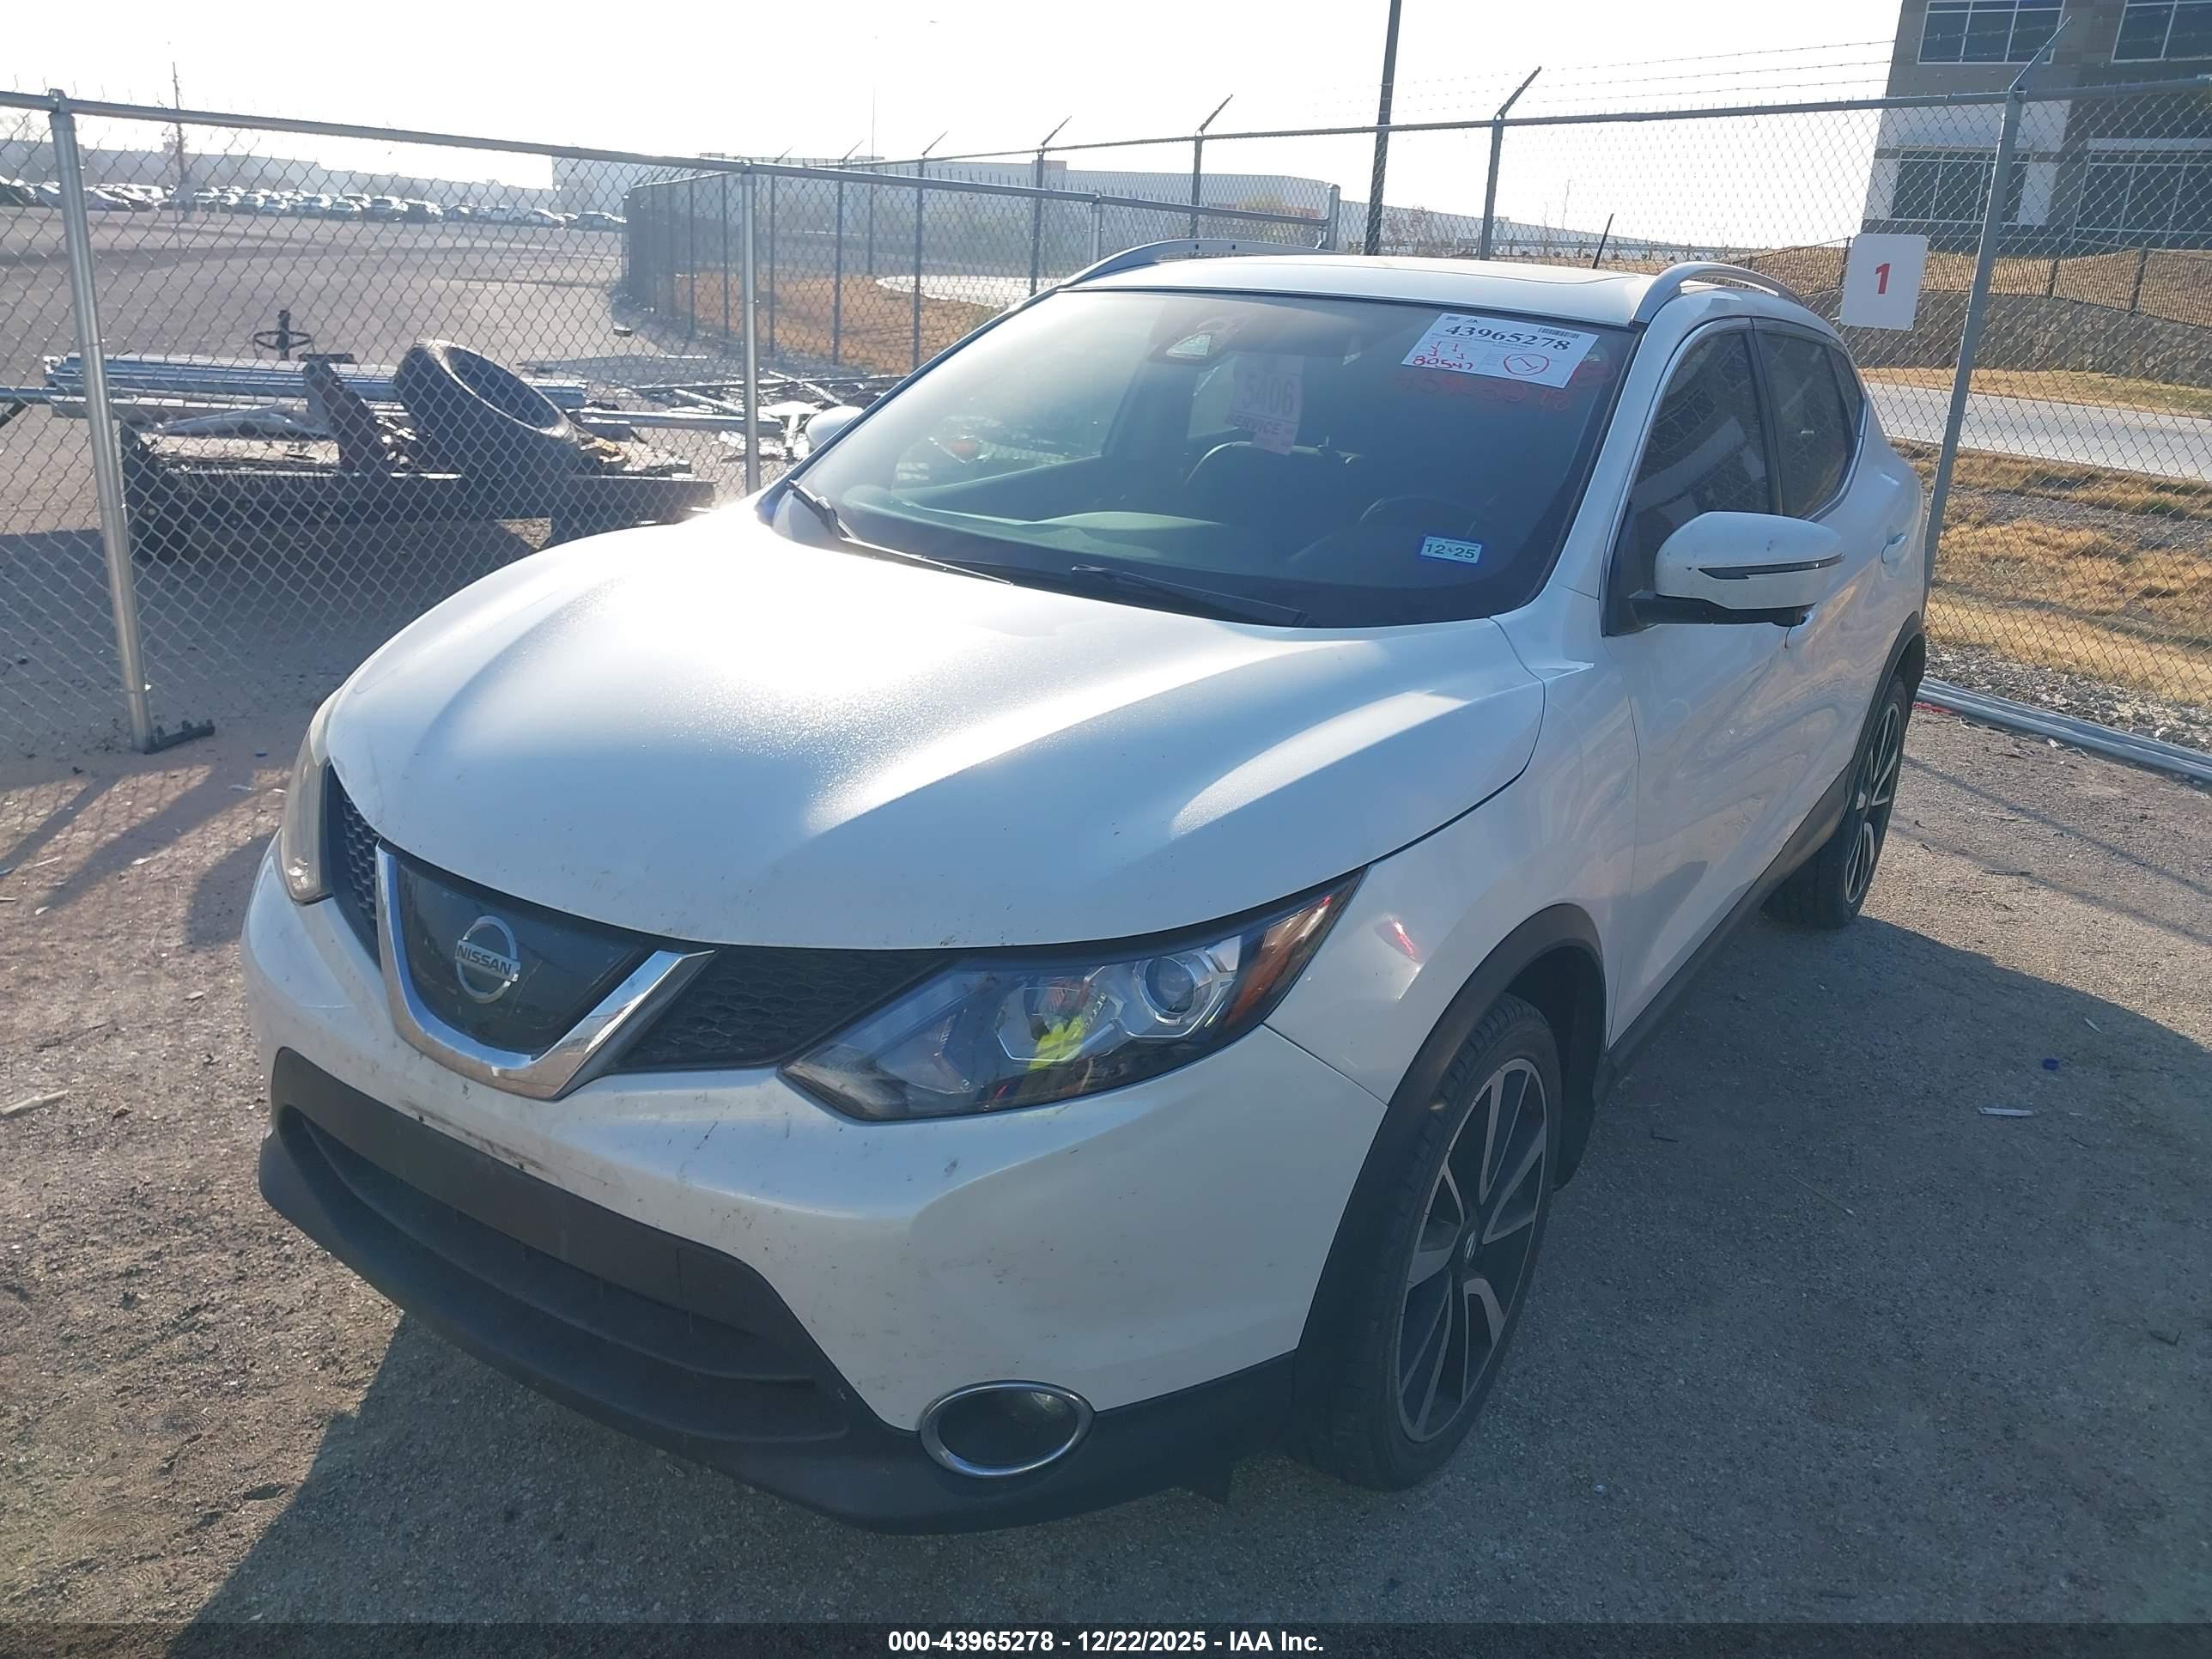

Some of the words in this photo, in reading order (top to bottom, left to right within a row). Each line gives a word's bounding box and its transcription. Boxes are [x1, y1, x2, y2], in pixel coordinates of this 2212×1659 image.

[1875, 262, 1891, 295] 1
[1444, 325, 1571, 351] 43965278
[457, 945, 512, 975] NISSAN
